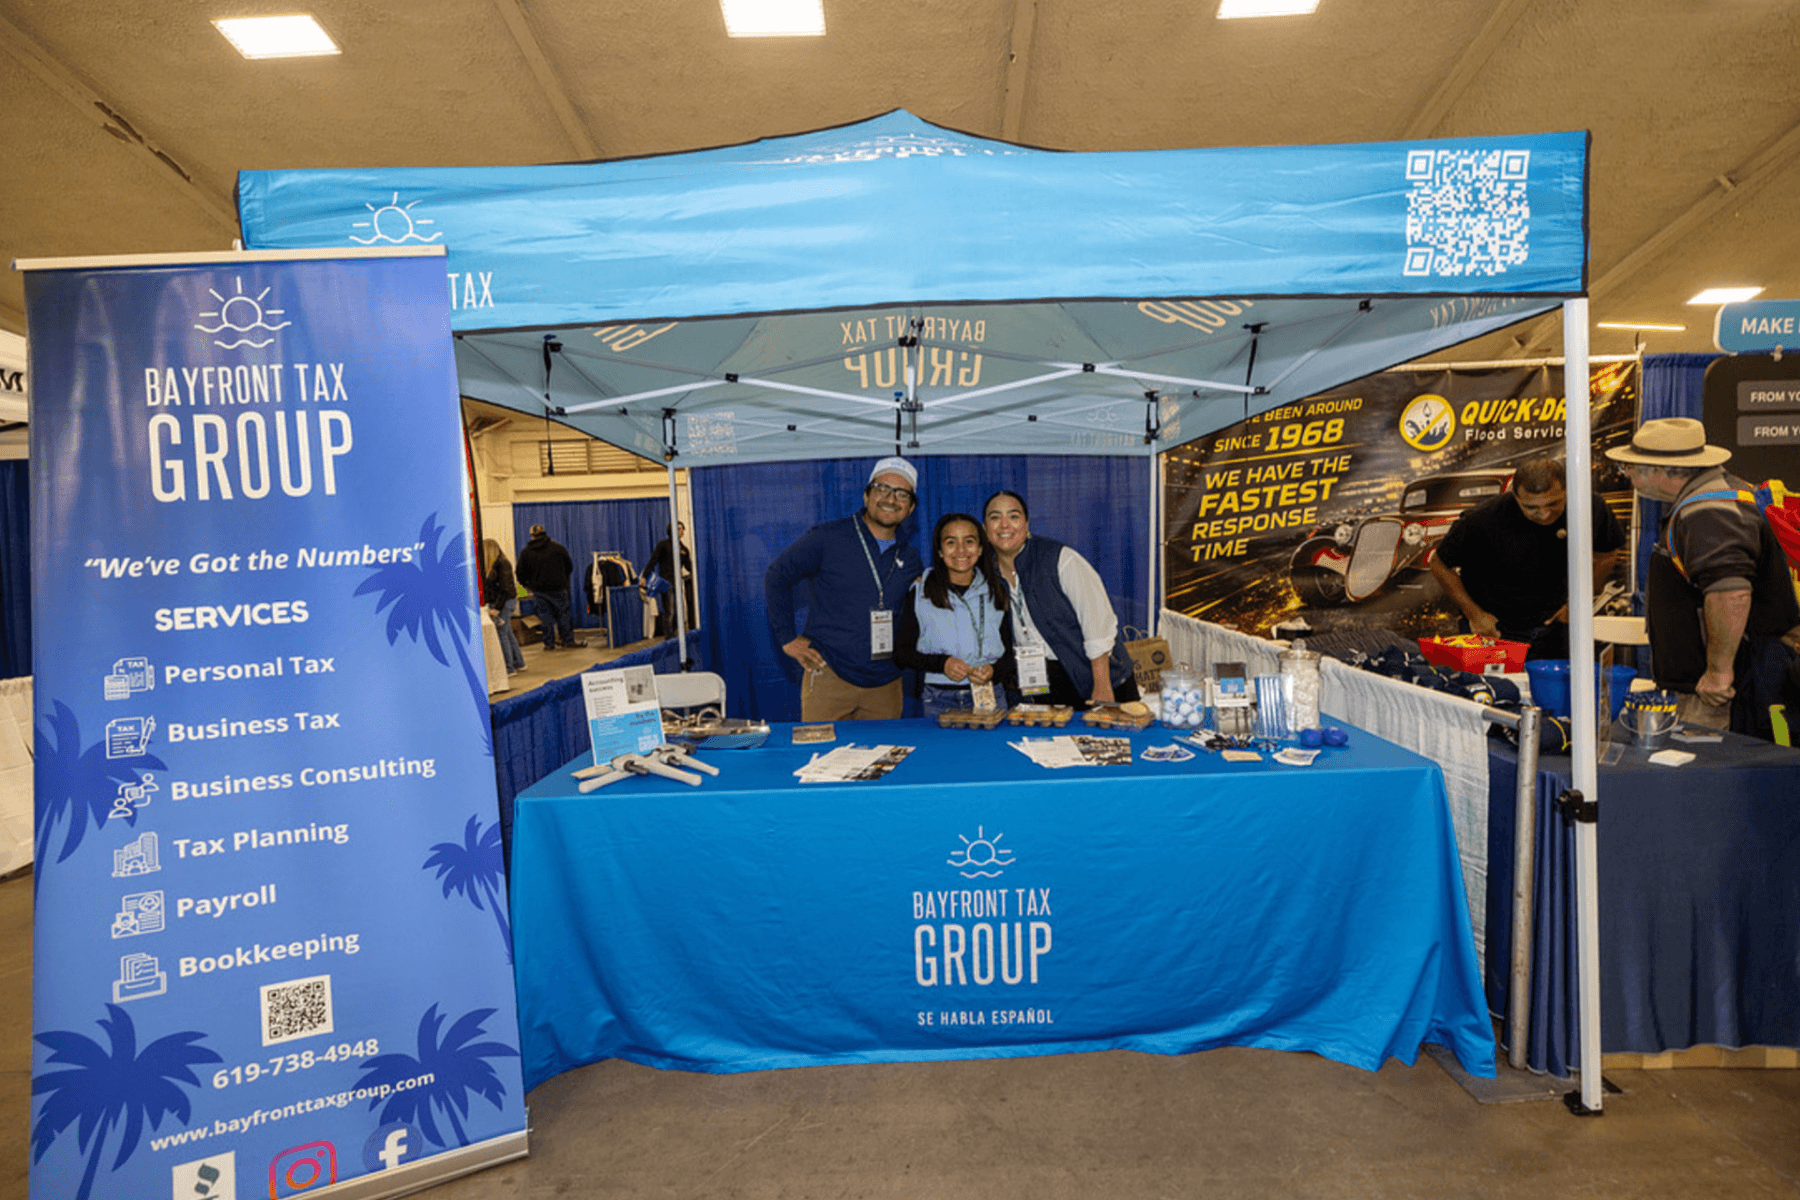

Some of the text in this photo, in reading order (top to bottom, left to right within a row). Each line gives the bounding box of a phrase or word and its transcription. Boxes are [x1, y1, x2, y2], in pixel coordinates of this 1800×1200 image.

[447, 271, 495, 310] TAX
[1741, 317, 1795, 335] MAKE
[145, 363, 348, 406] BAYFRONT TAX
[1750, 391, 1785, 402] FROM
[1306, 398, 1363, 416] AROUND
[1213, 418, 1345, 452] SINCE 1968
[1465, 427, 1506, 441] Flood
[1754, 426, 1788, 437] FROM
[148, 409, 353, 502] GROUP
[1205, 454, 1352, 489] WE HAVE THE
[1198, 477, 1338, 517] FASTEST
[1192, 506, 1318, 540] RESPONSE
[190, 551, 239, 574] Got
[248, 547, 289, 571] the
[1191, 538, 1249, 562] TIME
[155, 600, 309, 632] SERVICES
[165, 656, 335, 685] Personal Tax
[168, 712, 340, 742] Business Tax
[171, 757, 436, 801] Business Consulting
[174, 822, 349, 859] Tax Planning
[177, 885, 276, 918] Payroll
[913, 888, 1051, 919] BAYFRONT TAX
[179, 933, 360, 977] Bookkeeping
[914, 922, 1052, 986] GROUP
[918, 1008, 1054, 1025] SE HABLA ESPAÑOL
[213, 1038, 379, 1090] 619-738-4948
[150, 1070, 435, 1152] www.bayfronttaxgroup.com
